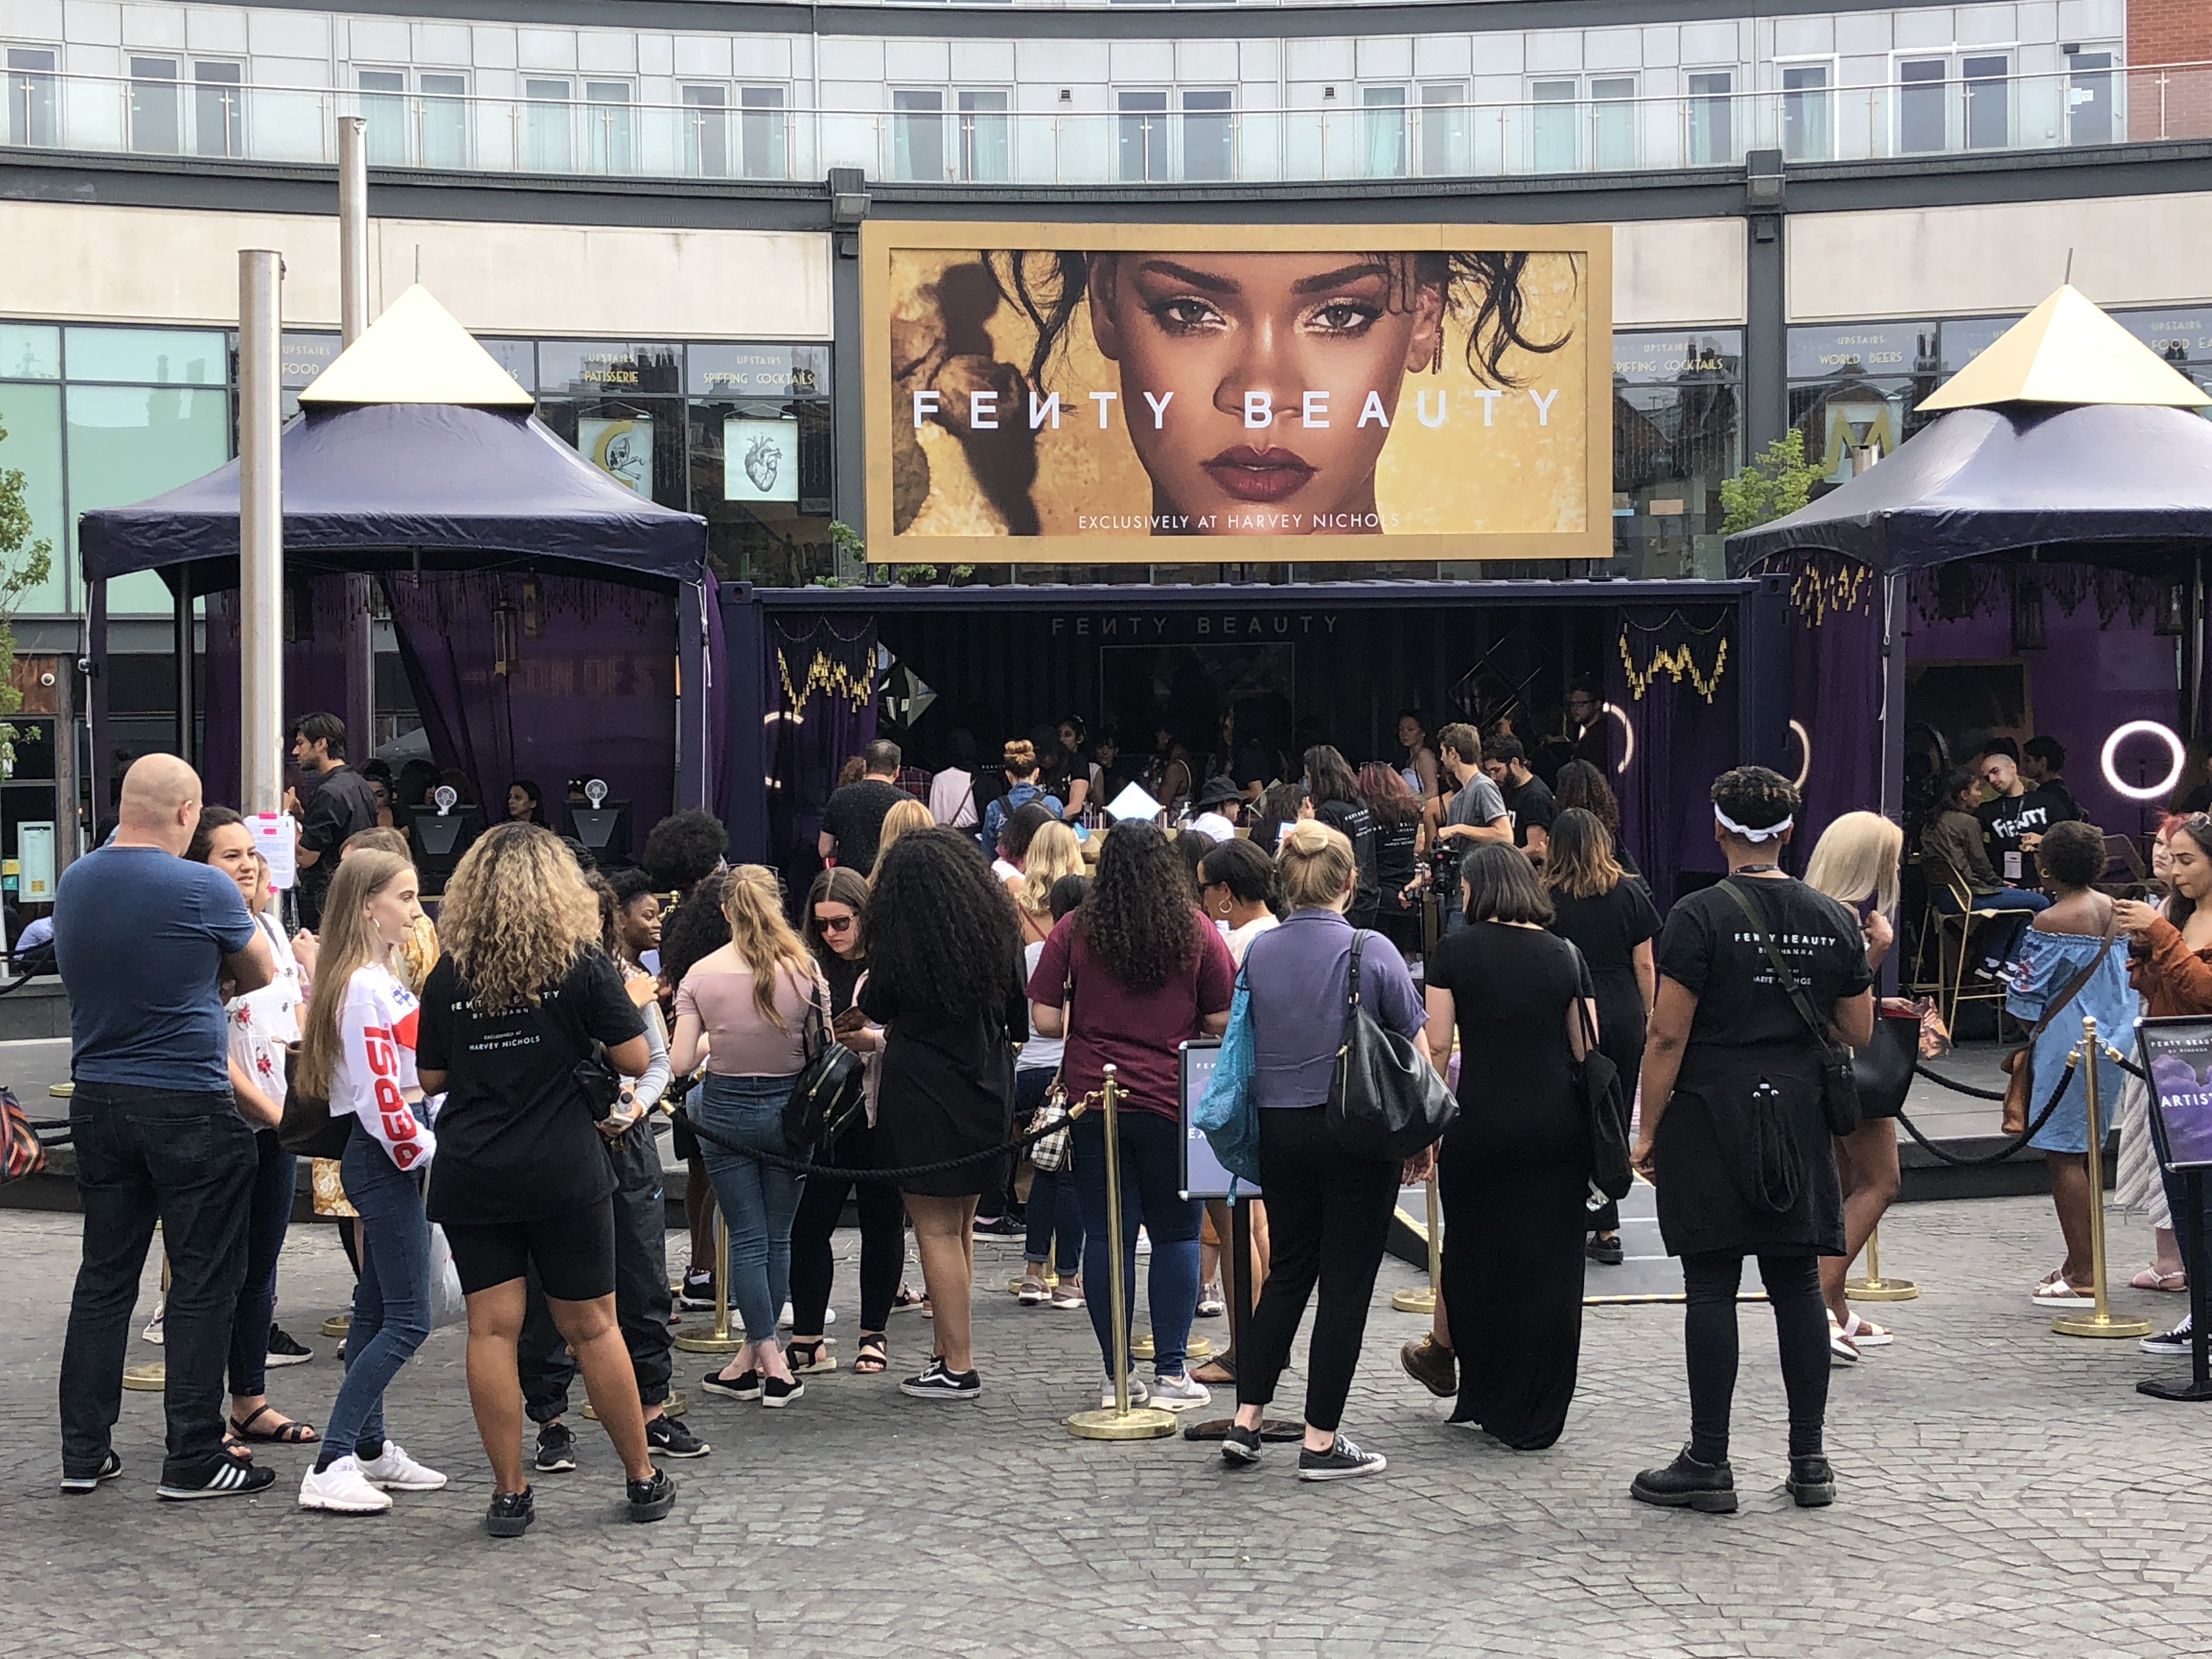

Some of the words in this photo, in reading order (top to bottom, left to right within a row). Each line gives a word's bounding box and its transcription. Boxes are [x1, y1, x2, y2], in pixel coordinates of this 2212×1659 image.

[2152, 320, 2202, 330] UPSTAIRS
[1838, 335, 1884, 345] UPSTAIRS
[2152, 338, 2190, 351] FOOD
[283, 345, 330, 355] UPSTAIRS
[1644, 342, 1689, 353] UPSTAIRS
[589, 353, 634, 363] UPSTAIRS
[737, 355, 781, 365] UPSTAIRS
[1820, 353, 1860, 365] WORLD
[1869, 351, 1903, 364] BEERS
[282, 363, 319, 375] FOOD
[1664, 358, 1723, 371] COCKTAILS
[585, 371, 639, 383] PATISSERIE
[703, 373, 748, 384] SPIFFING
[756, 373, 814, 385] COCKTAILS
[1244, 389, 1559, 429] BEAUTY
[1078, 515, 1189, 529] EXCLUSIVELY
[1197, 515, 1217, 529] AT
[1228, 514, 1302, 529] HARVEY
[1312, 512, 1400, 528] NICHOLS
[1197, 616, 1337, 634] BEAUTY
[1991, 806, 2047, 839] FENTY
[1734, 933, 1776, 943] FENY
[469, 1042, 499, 1051] HARVEY
[501, 1035, 541, 1048] NICHOLS
[363, 1025, 424, 1169] PEPSI
